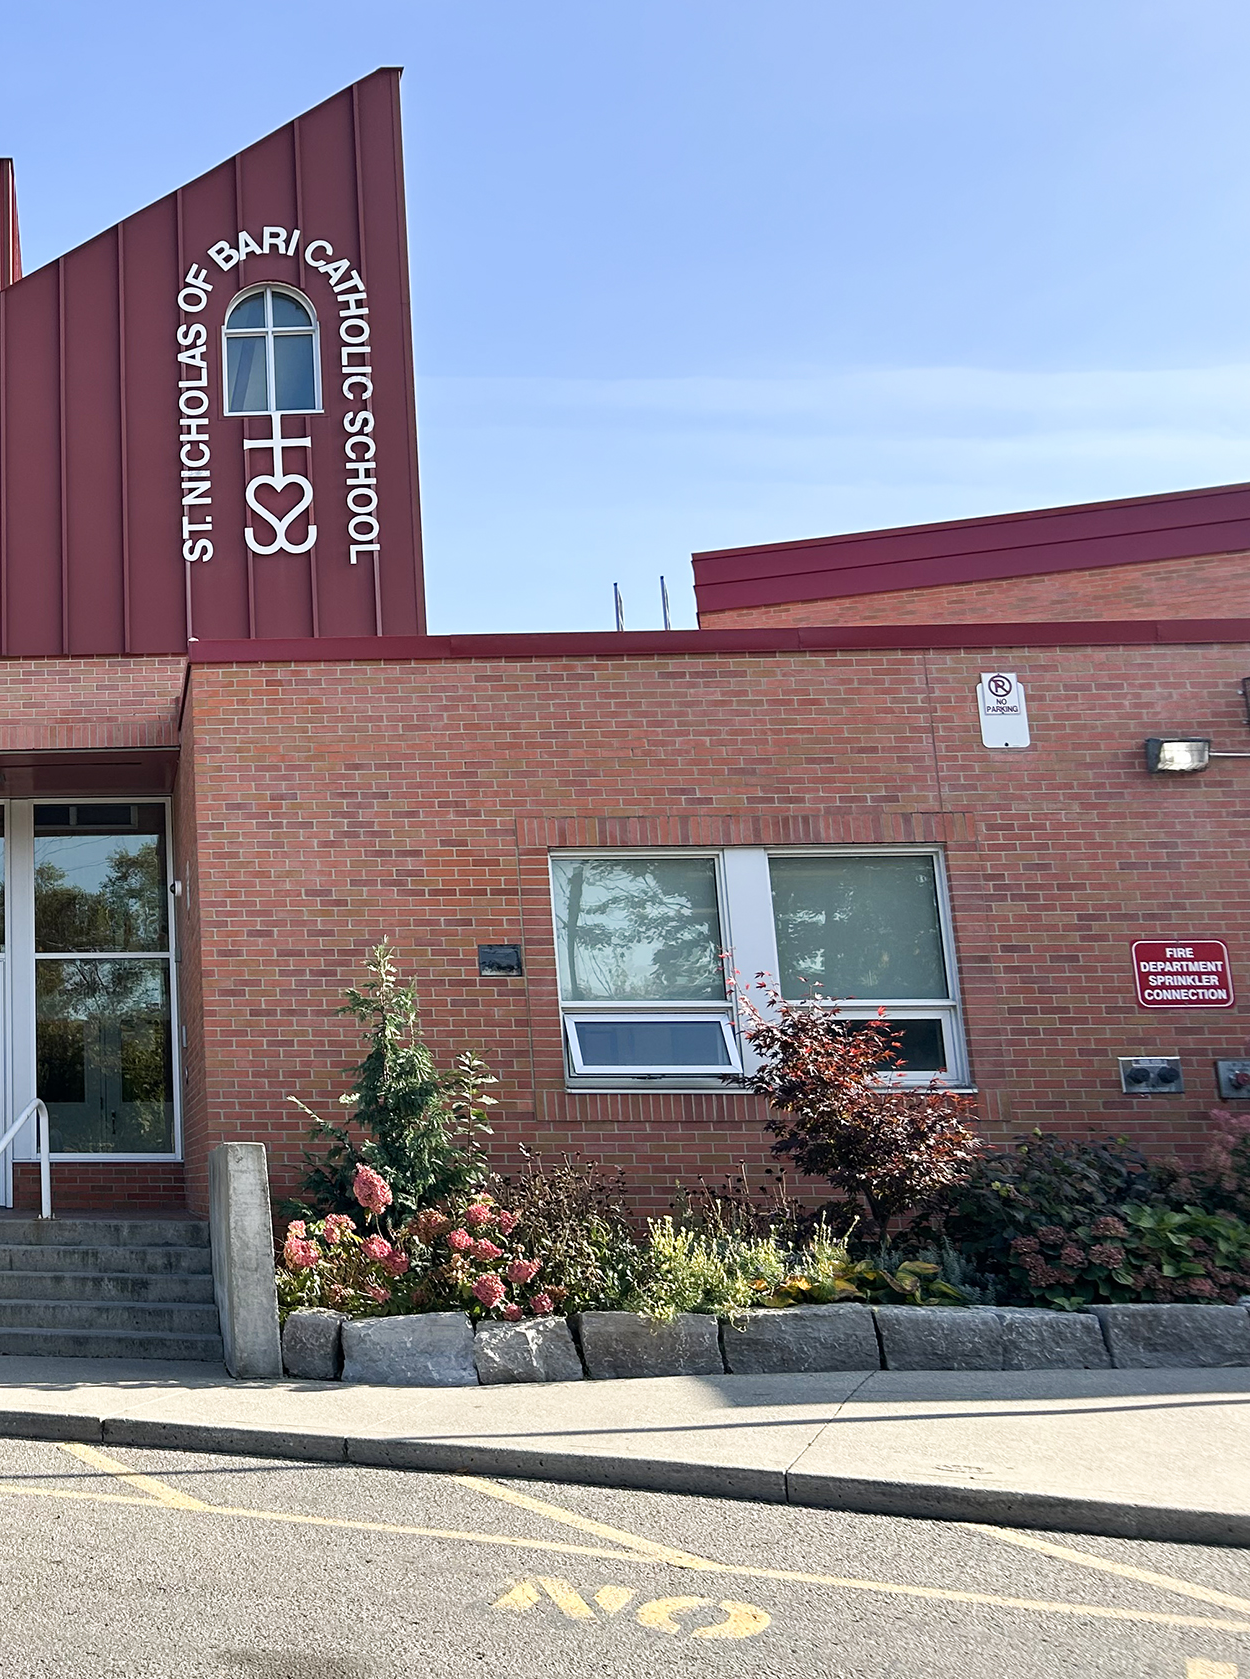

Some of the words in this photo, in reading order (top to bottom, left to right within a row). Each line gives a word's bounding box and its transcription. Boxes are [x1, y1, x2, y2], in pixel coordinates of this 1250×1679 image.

[206, 226, 301, 272] BARI
[177, 263, 214, 313] OF
[304, 239, 374, 401] CATHOLIC
[177, 323, 211, 506] NICHOLAS
[342, 411, 380, 565] SCHOOL
[182, 515, 214, 563] ST.
[986, 705, 1018, 713] PARKING
[1140, 961, 1223, 972] DEPARTMENT
[1165, 947, 1195, 958] FIRE
[1144, 989, 1227, 1000] CONNECTION
[1148, 975, 1219, 986] SPRINKLER
[488, 1576, 772, 1640] NO
